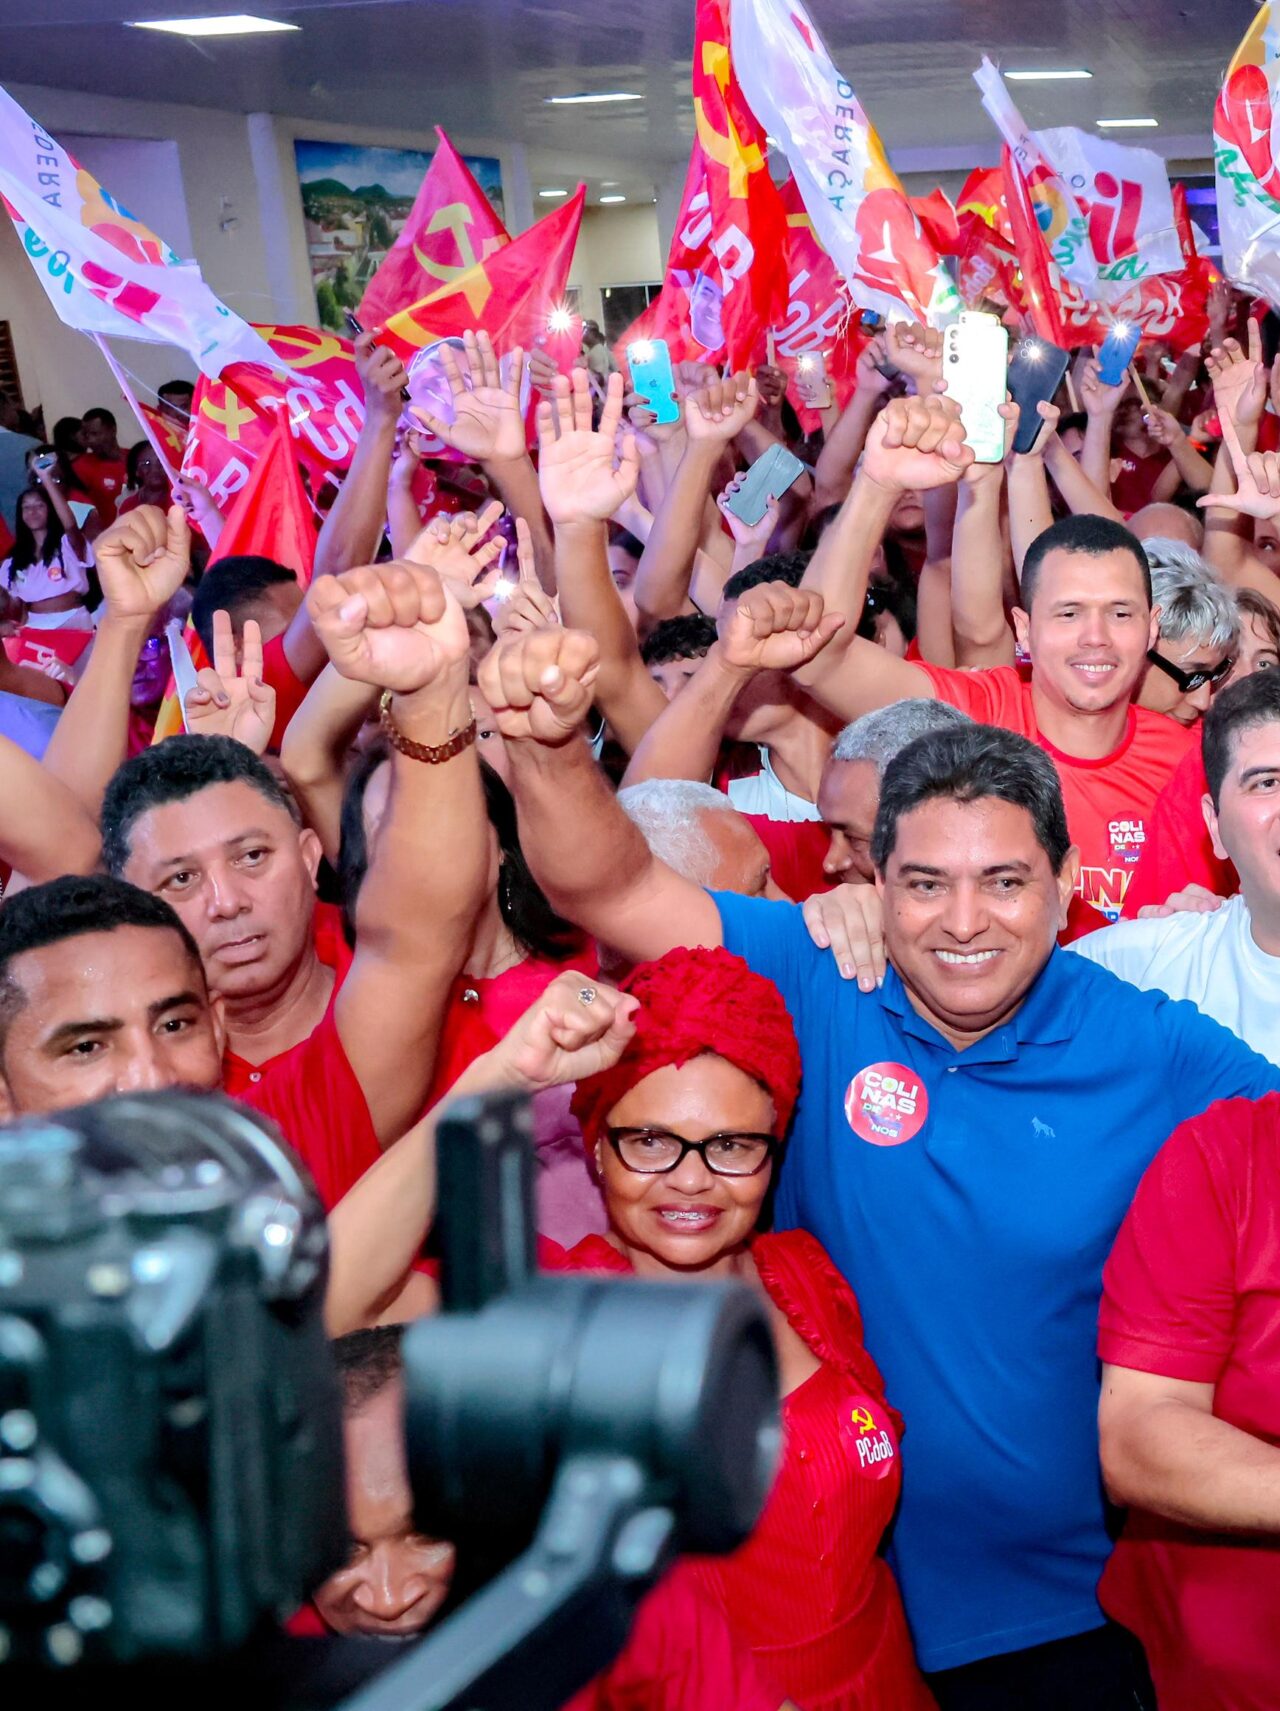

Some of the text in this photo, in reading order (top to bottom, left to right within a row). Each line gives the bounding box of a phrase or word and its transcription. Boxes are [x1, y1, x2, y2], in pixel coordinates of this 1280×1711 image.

[1108, 820, 1143, 833] COLI
[1110, 832, 1145, 844] NAS
[864, 1071, 919, 1099] COLI
[860, 1085, 917, 1115] NAS
[855, 1430, 894, 1468] PCdoB
